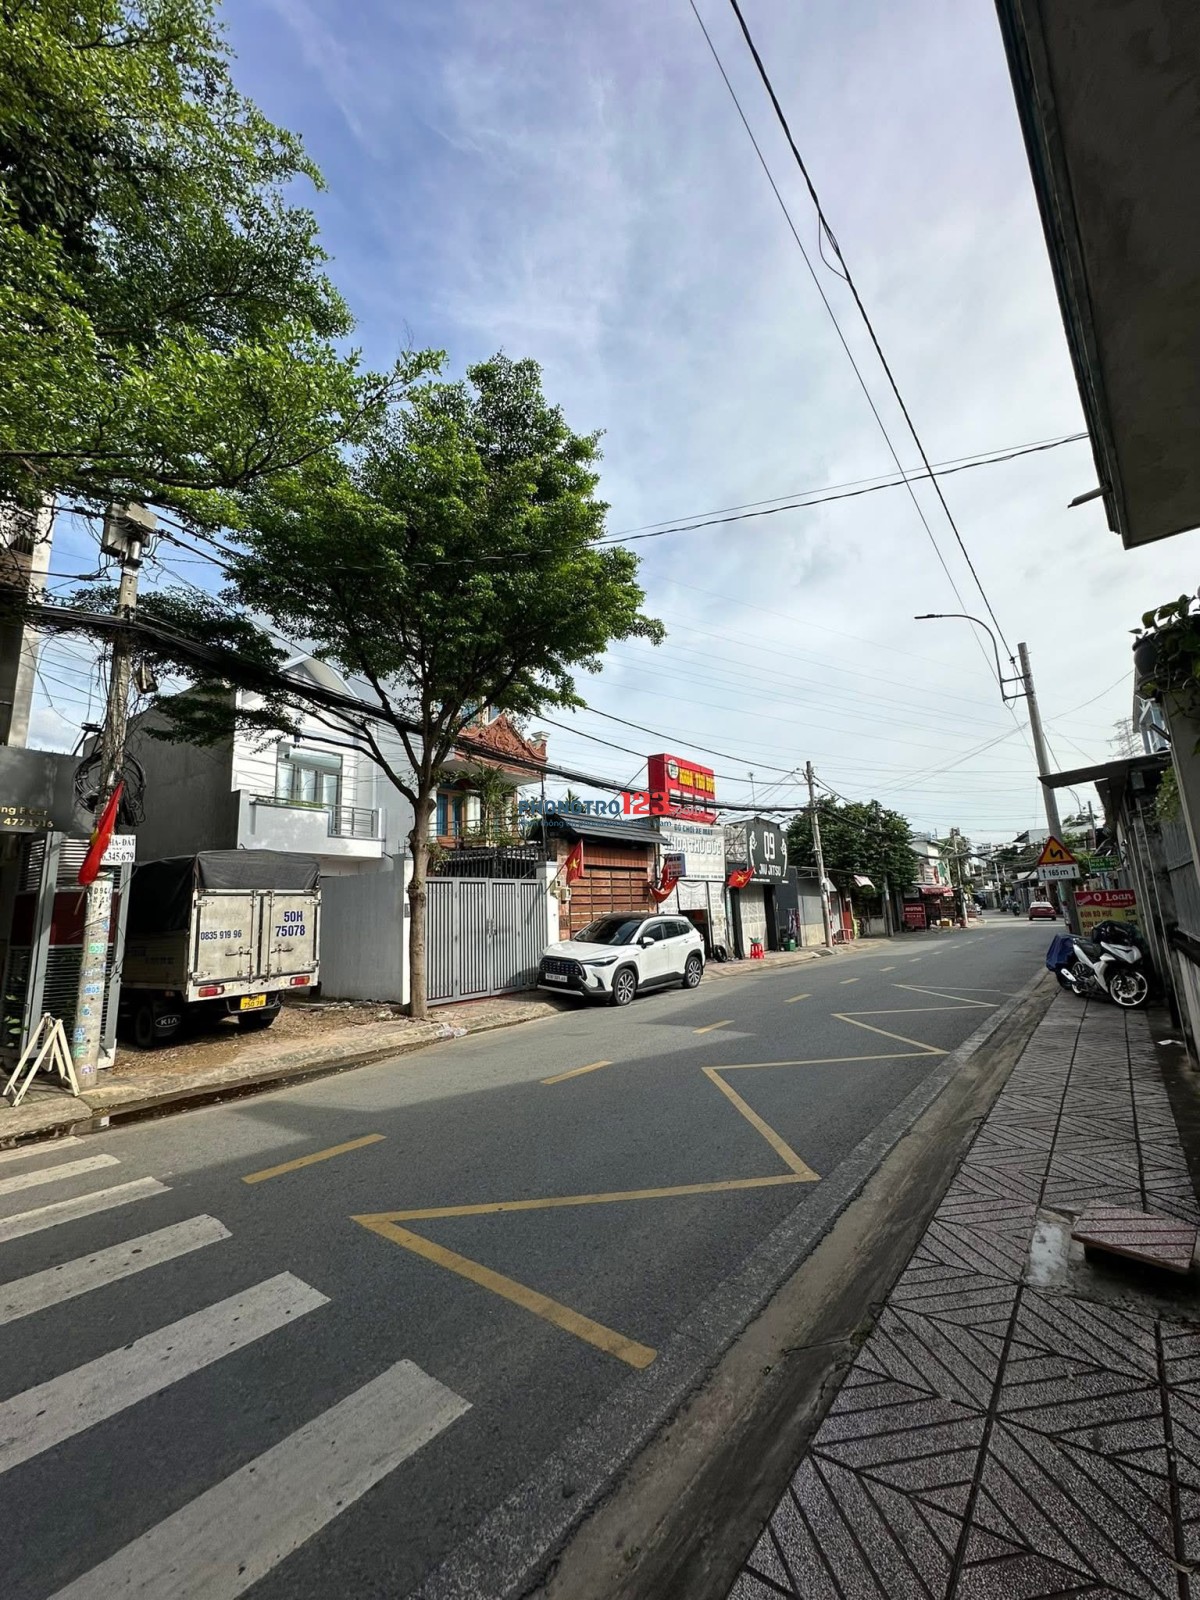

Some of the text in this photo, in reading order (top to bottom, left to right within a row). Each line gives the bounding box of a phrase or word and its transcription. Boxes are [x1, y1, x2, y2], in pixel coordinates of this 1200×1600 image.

[1105, 892, 1133, 902] Loan
[283, 911, 303, 923] 50H
[200, 929, 242, 941] 0835 919 96
[275, 924, 306, 938] 75078
[160, 1016, 177, 1026] KIA
